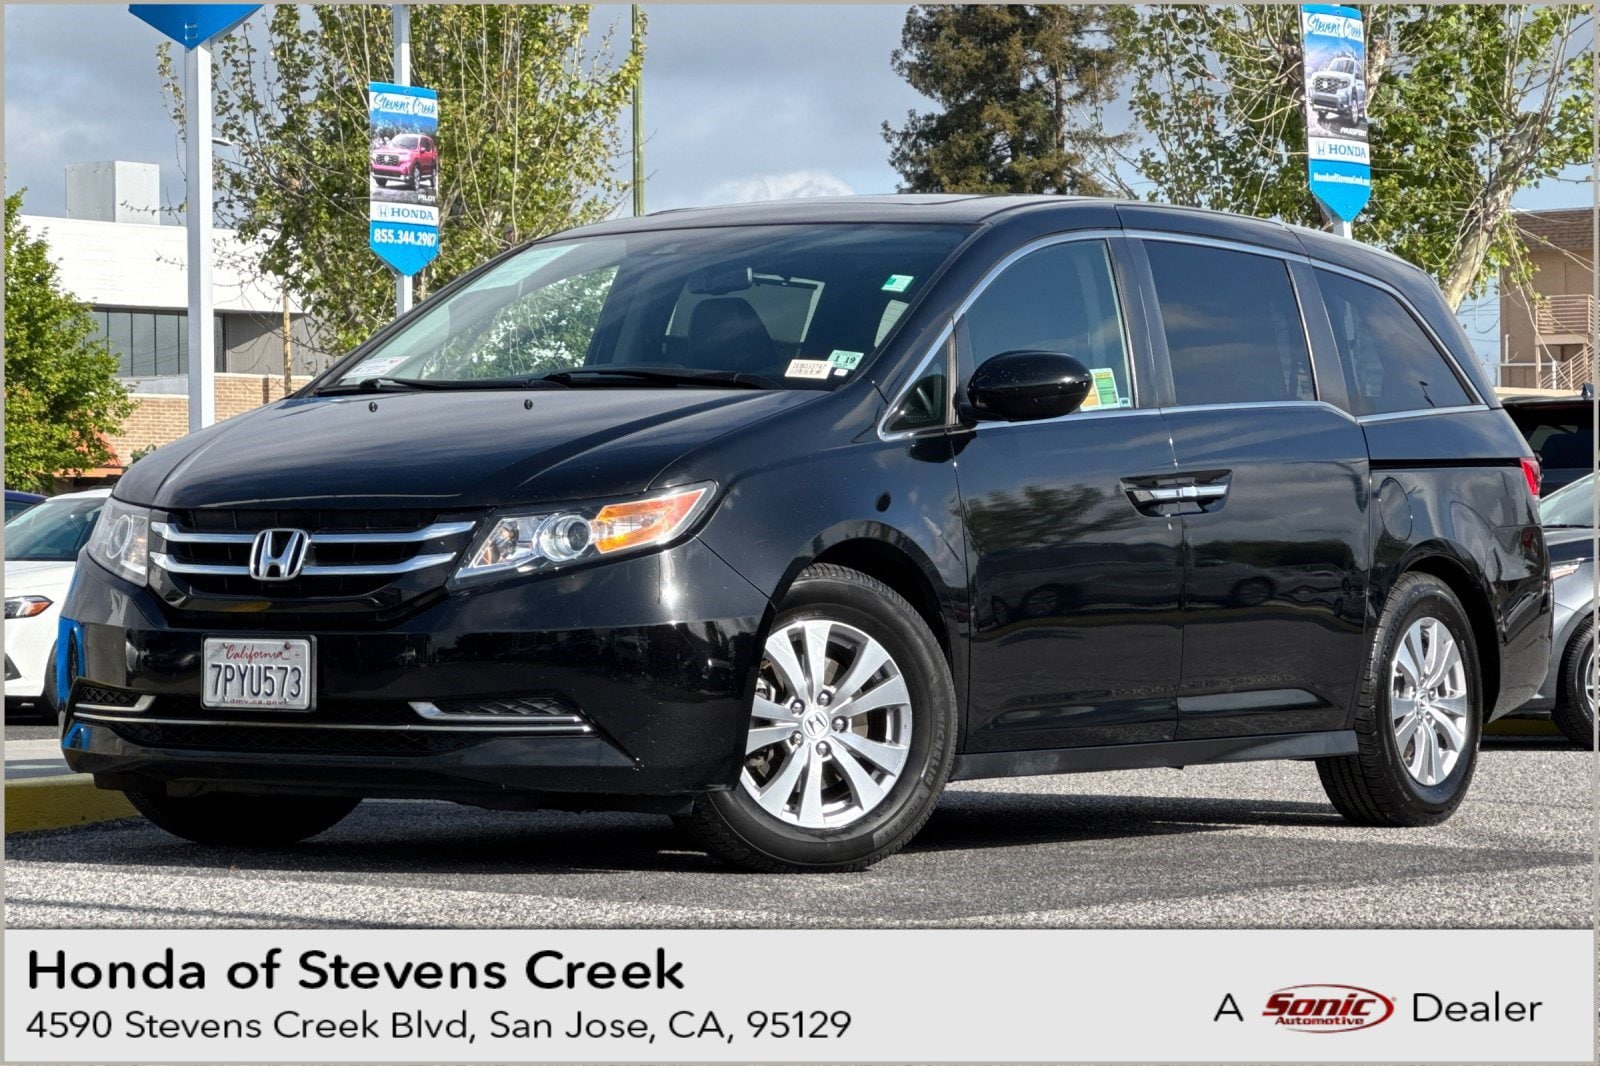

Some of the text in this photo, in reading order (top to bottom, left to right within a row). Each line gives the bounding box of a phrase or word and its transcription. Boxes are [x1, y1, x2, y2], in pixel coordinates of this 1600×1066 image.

[373, 91, 436, 116] Stevens Creek
[1328, 144, 1366, 158] HONDA
[390, 208, 434, 221] HONDA
[844, 356, 856, 364] 19
[226, 643, 291, 664] California
[210, 664, 302, 698] 7PYU573
